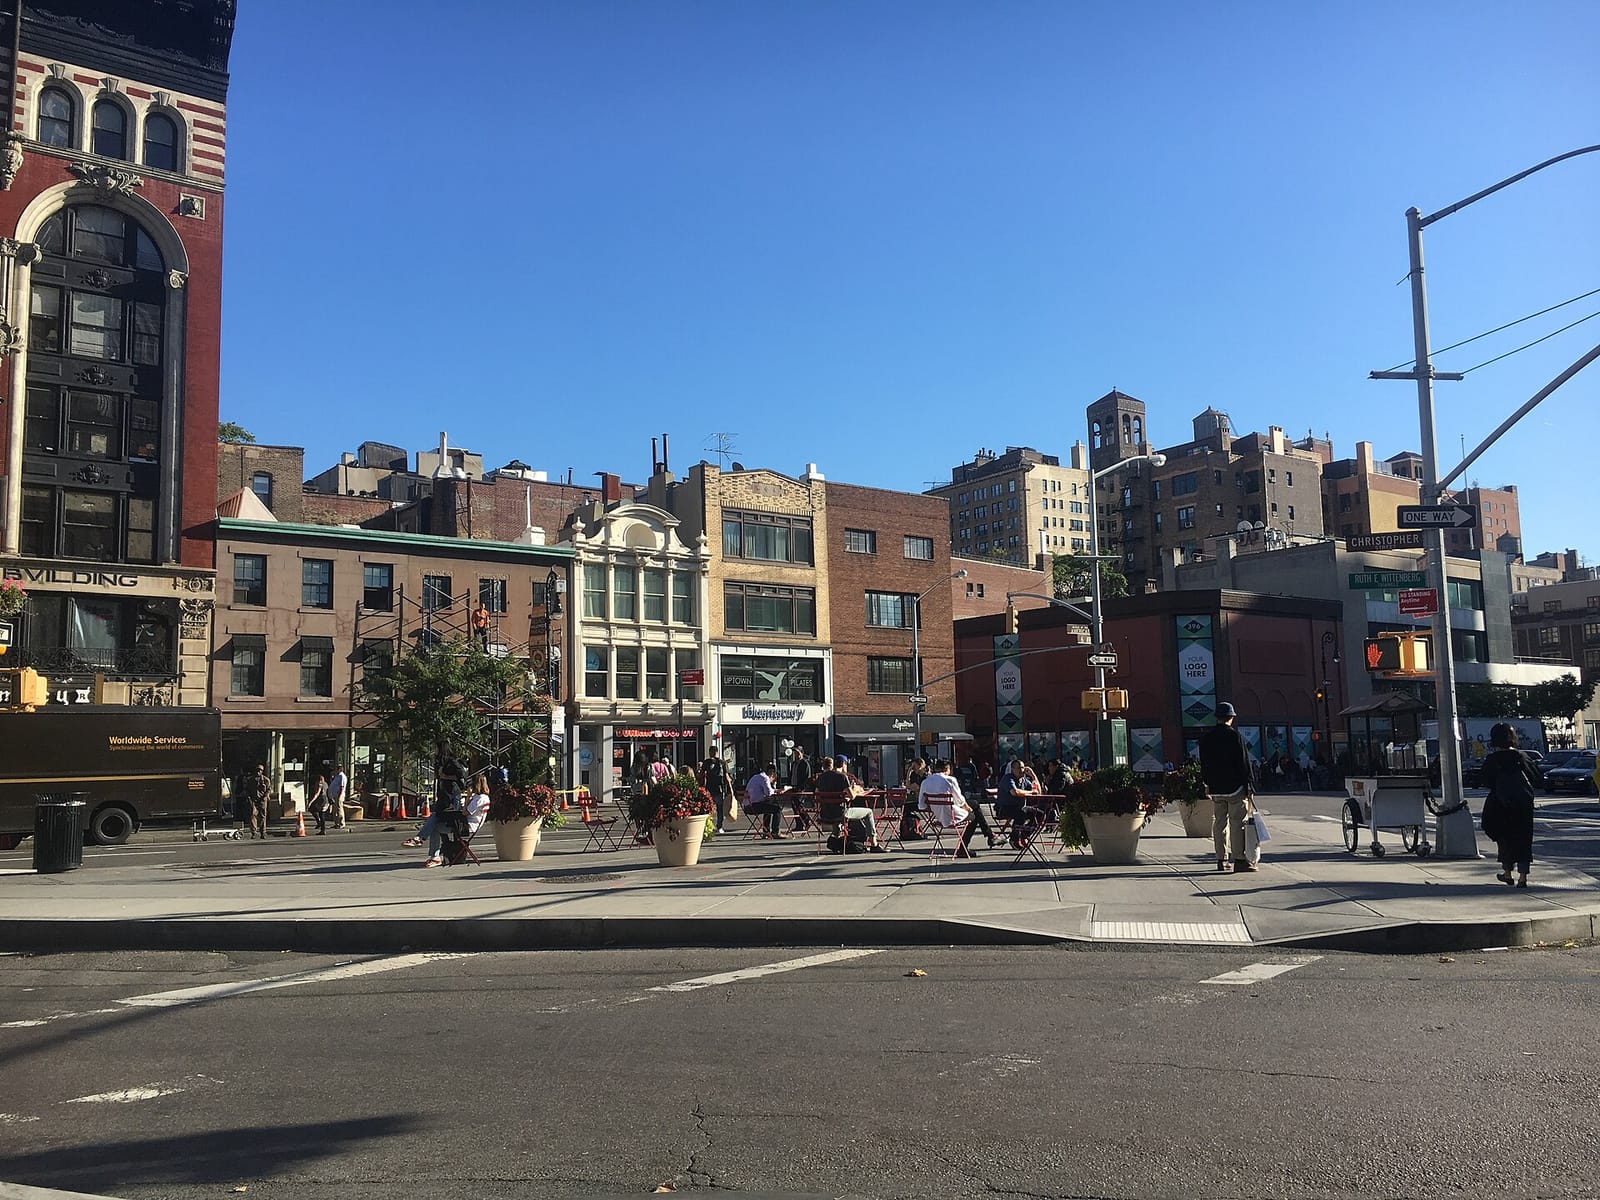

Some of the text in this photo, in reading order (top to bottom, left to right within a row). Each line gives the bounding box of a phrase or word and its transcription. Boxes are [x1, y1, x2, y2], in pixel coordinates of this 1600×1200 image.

[1406, 512, 1455, 521] ONE WAY
[1351, 534, 1419, 547] CHRISTOPHER
[1354, 574, 1371, 583] RUTH
[1381, 572, 1421, 583] WITTENBERG
[1186, 670, 1207, 678] HERE
[723, 675, 813, 687] UPTOWN PILATES
[109, 735, 186, 744] Worldwide Services
